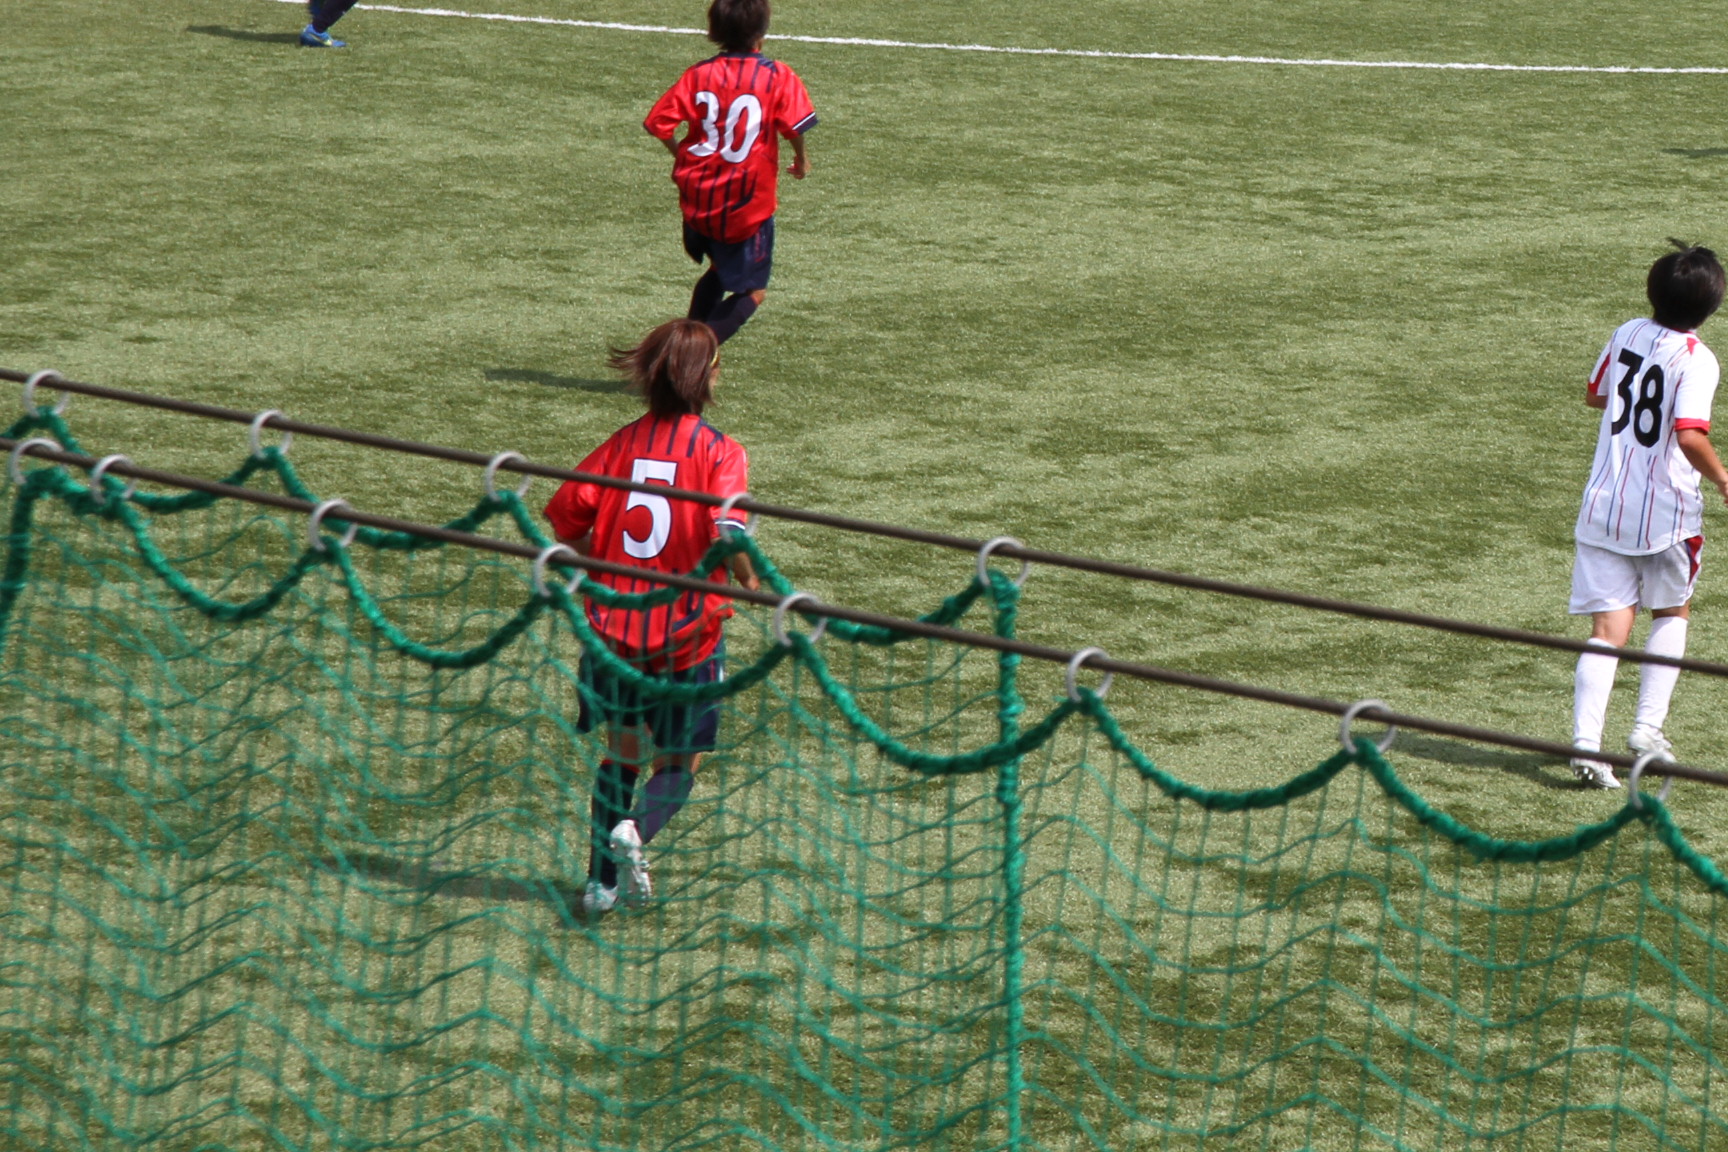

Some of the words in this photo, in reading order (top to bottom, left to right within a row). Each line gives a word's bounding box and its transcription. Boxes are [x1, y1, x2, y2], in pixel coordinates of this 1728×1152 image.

[686, 90, 763, 164] 30
[1611, 347, 1665, 448] 38
[622, 457, 678, 560] 5
